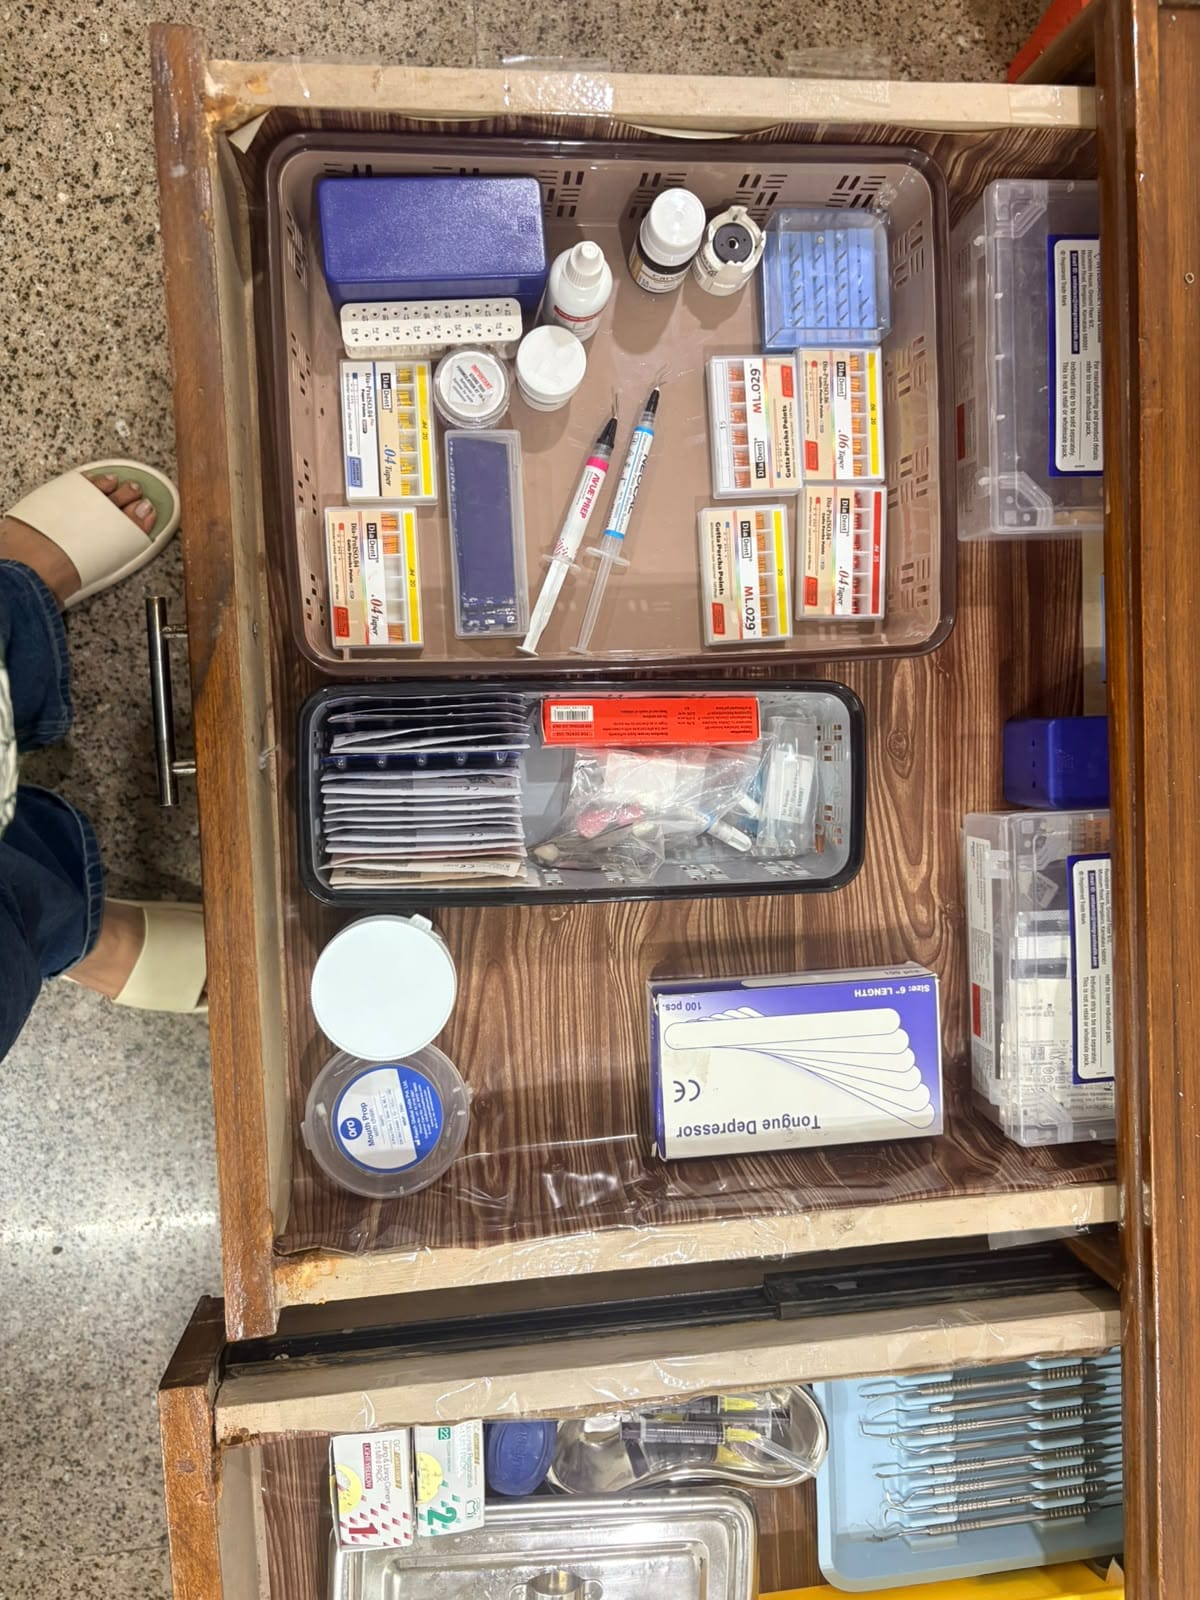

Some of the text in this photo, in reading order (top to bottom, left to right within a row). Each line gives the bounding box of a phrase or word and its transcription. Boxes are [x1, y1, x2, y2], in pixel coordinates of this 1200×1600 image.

[470, 363, 493, 390] IMPORTANT
[750, 368, 762, 413] ML.029
[422, 432, 428, 440] 20
[838, 430, 849, 469] .06 Taper
[384, 445, 396, 486] .04 Taper
[838, 566, 849, 585] .04
[370, 595, 383, 636] .04 Taper
[744, 586, 755, 630] ML.029
[854, 987, 895, 998] LENGTH
[908, 984, 931, 993] Size:
[662, 1001, 702, 1012] 100 pcs.
[673, 1079, 701, 1103] CE
[346, 1120, 357, 1137] oro
[358, 1101, 375, 1146] Mouth Prop
[676, 1114, 821, 1139] Tongue Depressor
[440, 1429, 448, 1439] 22
[427, 1507, 457, 1525] 2
[349, 1523, 378, 1535] 1
